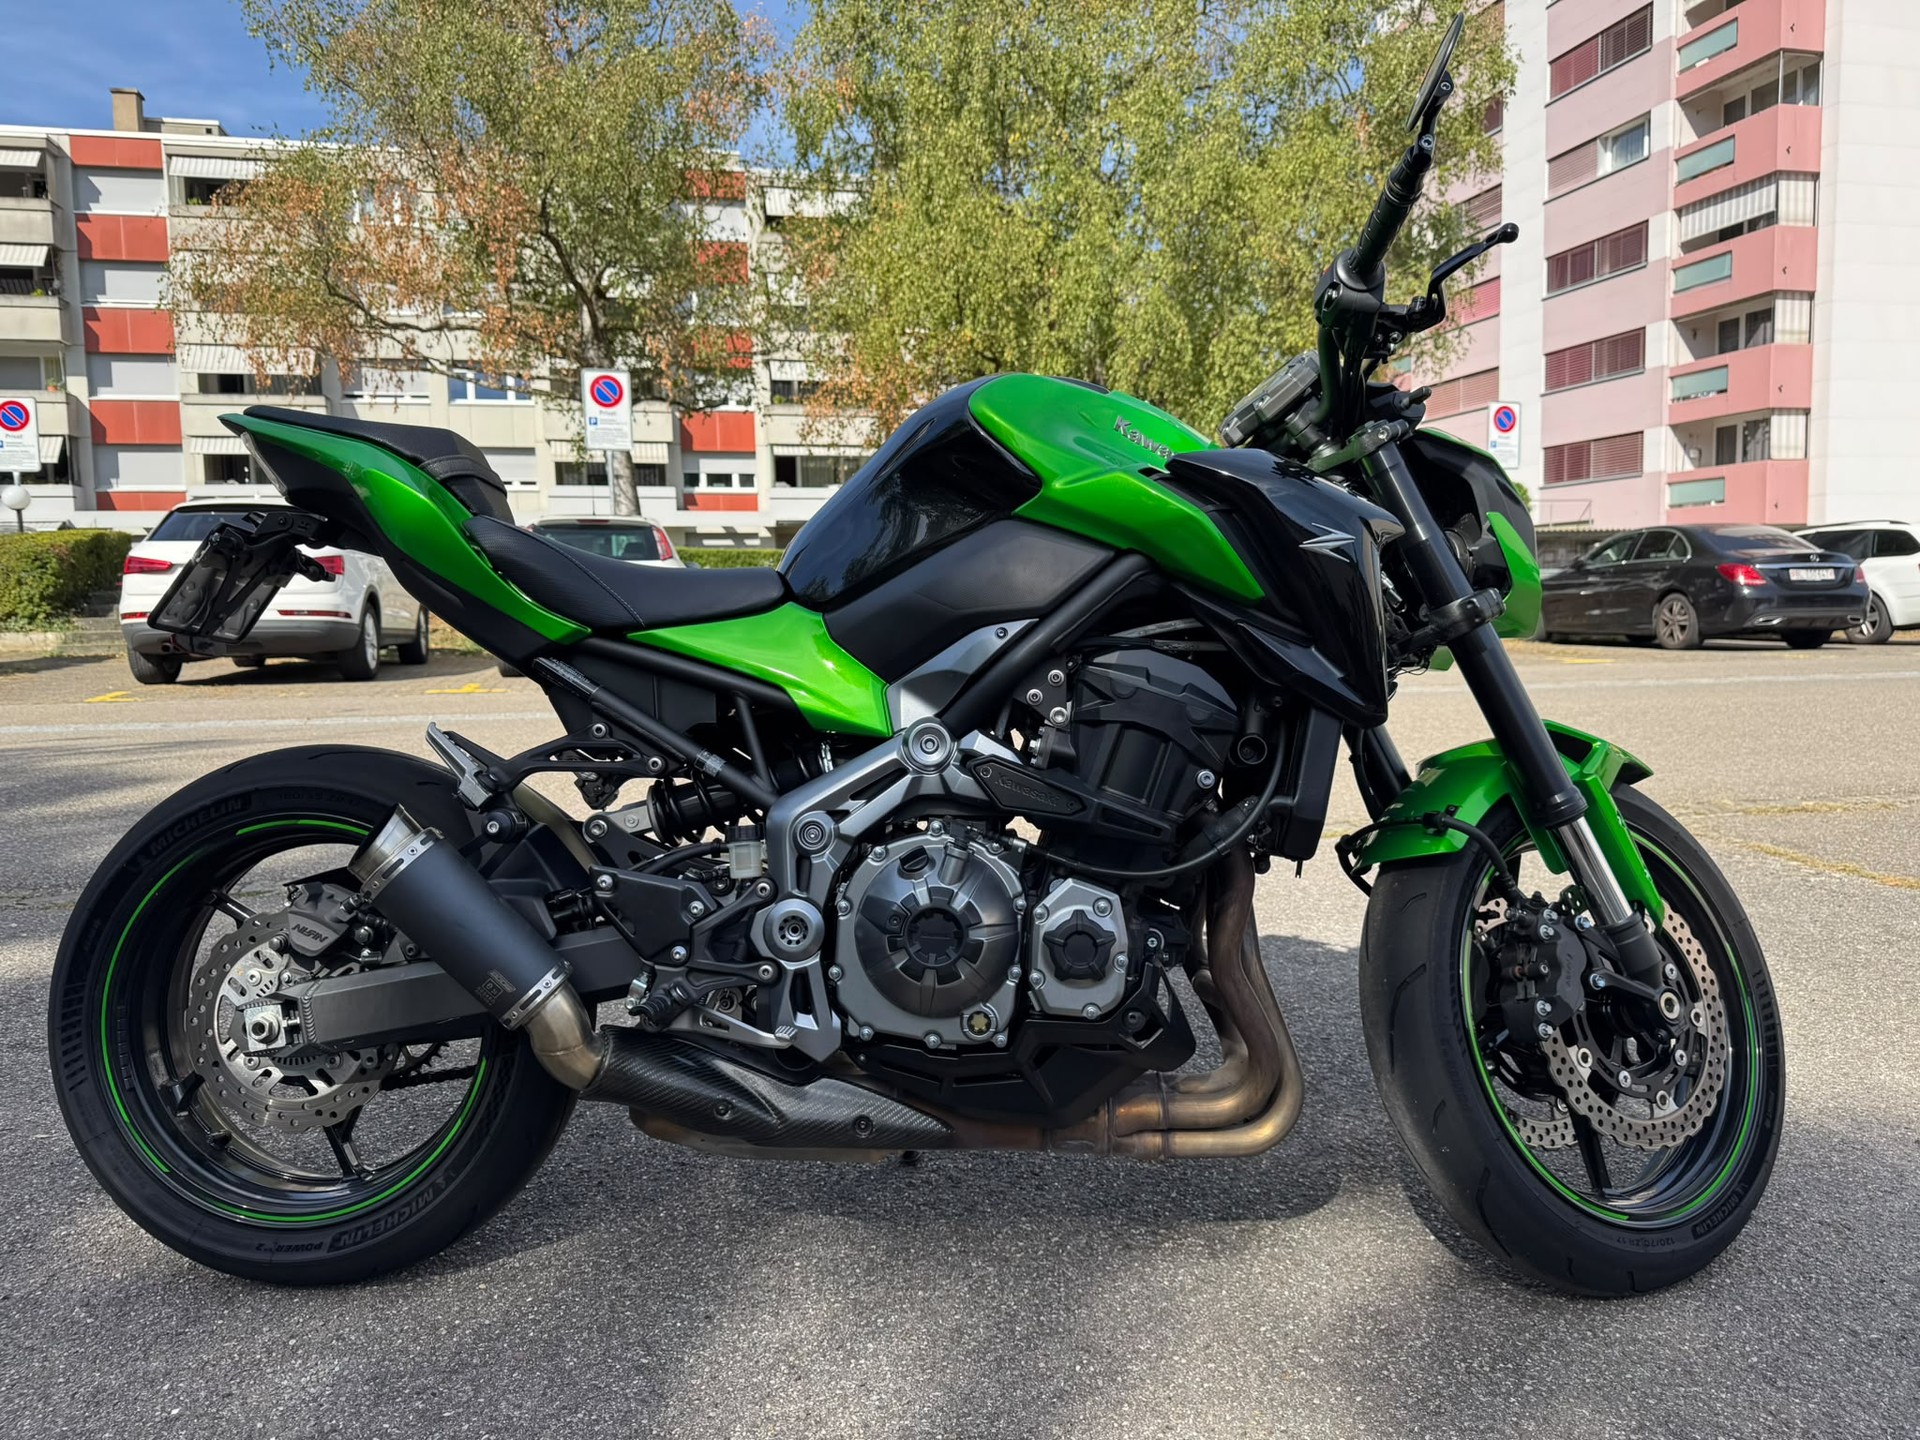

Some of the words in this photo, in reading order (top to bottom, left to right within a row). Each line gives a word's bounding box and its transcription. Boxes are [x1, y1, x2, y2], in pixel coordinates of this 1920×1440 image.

[1113, 415, 1175, 459] Kawa
[995, 774, 1061, 807] Kawasaki
[150, 795, 244, 855] MICHELIN
[339, 1190, 434, 1248] MICHELIN
[1695, 1194, 1738, 1235] MICHELIN
[275, 1241, 324, 1253] POWER
